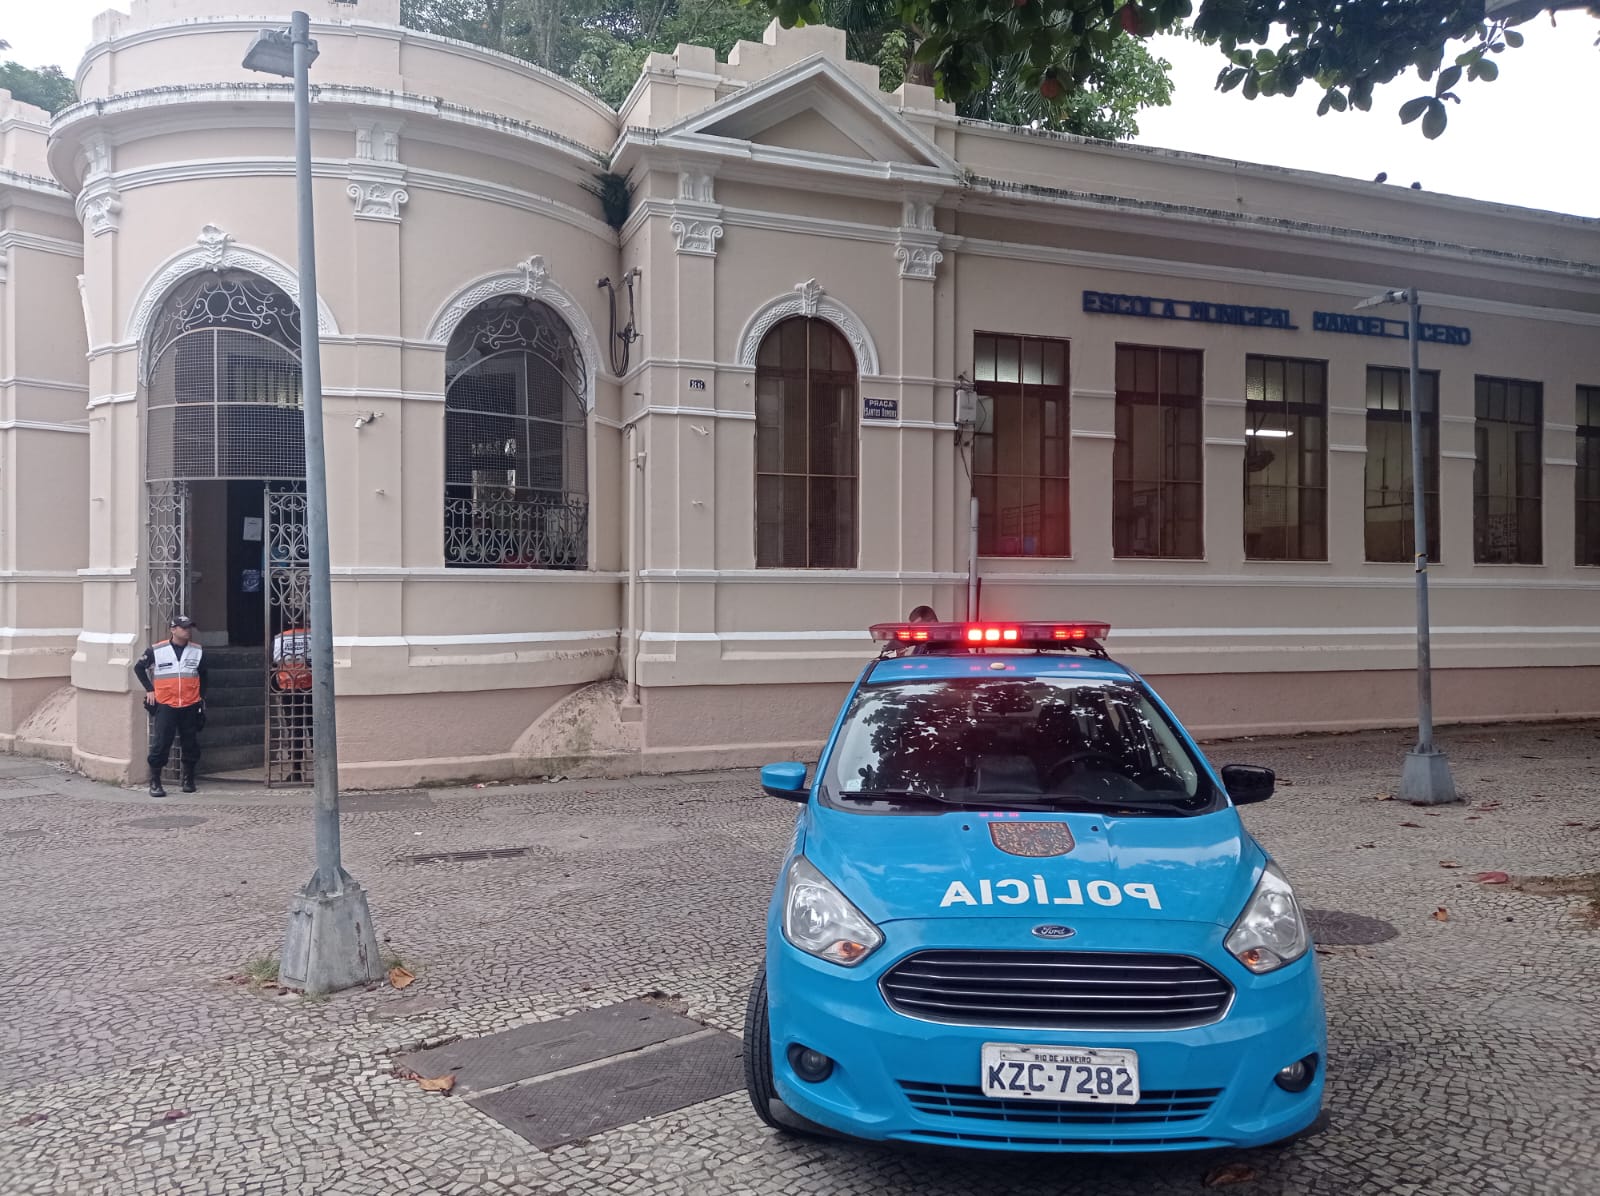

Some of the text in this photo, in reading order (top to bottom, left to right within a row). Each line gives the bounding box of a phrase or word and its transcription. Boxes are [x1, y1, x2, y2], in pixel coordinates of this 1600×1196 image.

[1083, 290, 1471, 346] ESCOLA MUNICIPAL MANOEL CERO
[1041, 926, 1065, 935] Ford
[1035, 1054, 1092, 1064] RIO DE JANEIRO
